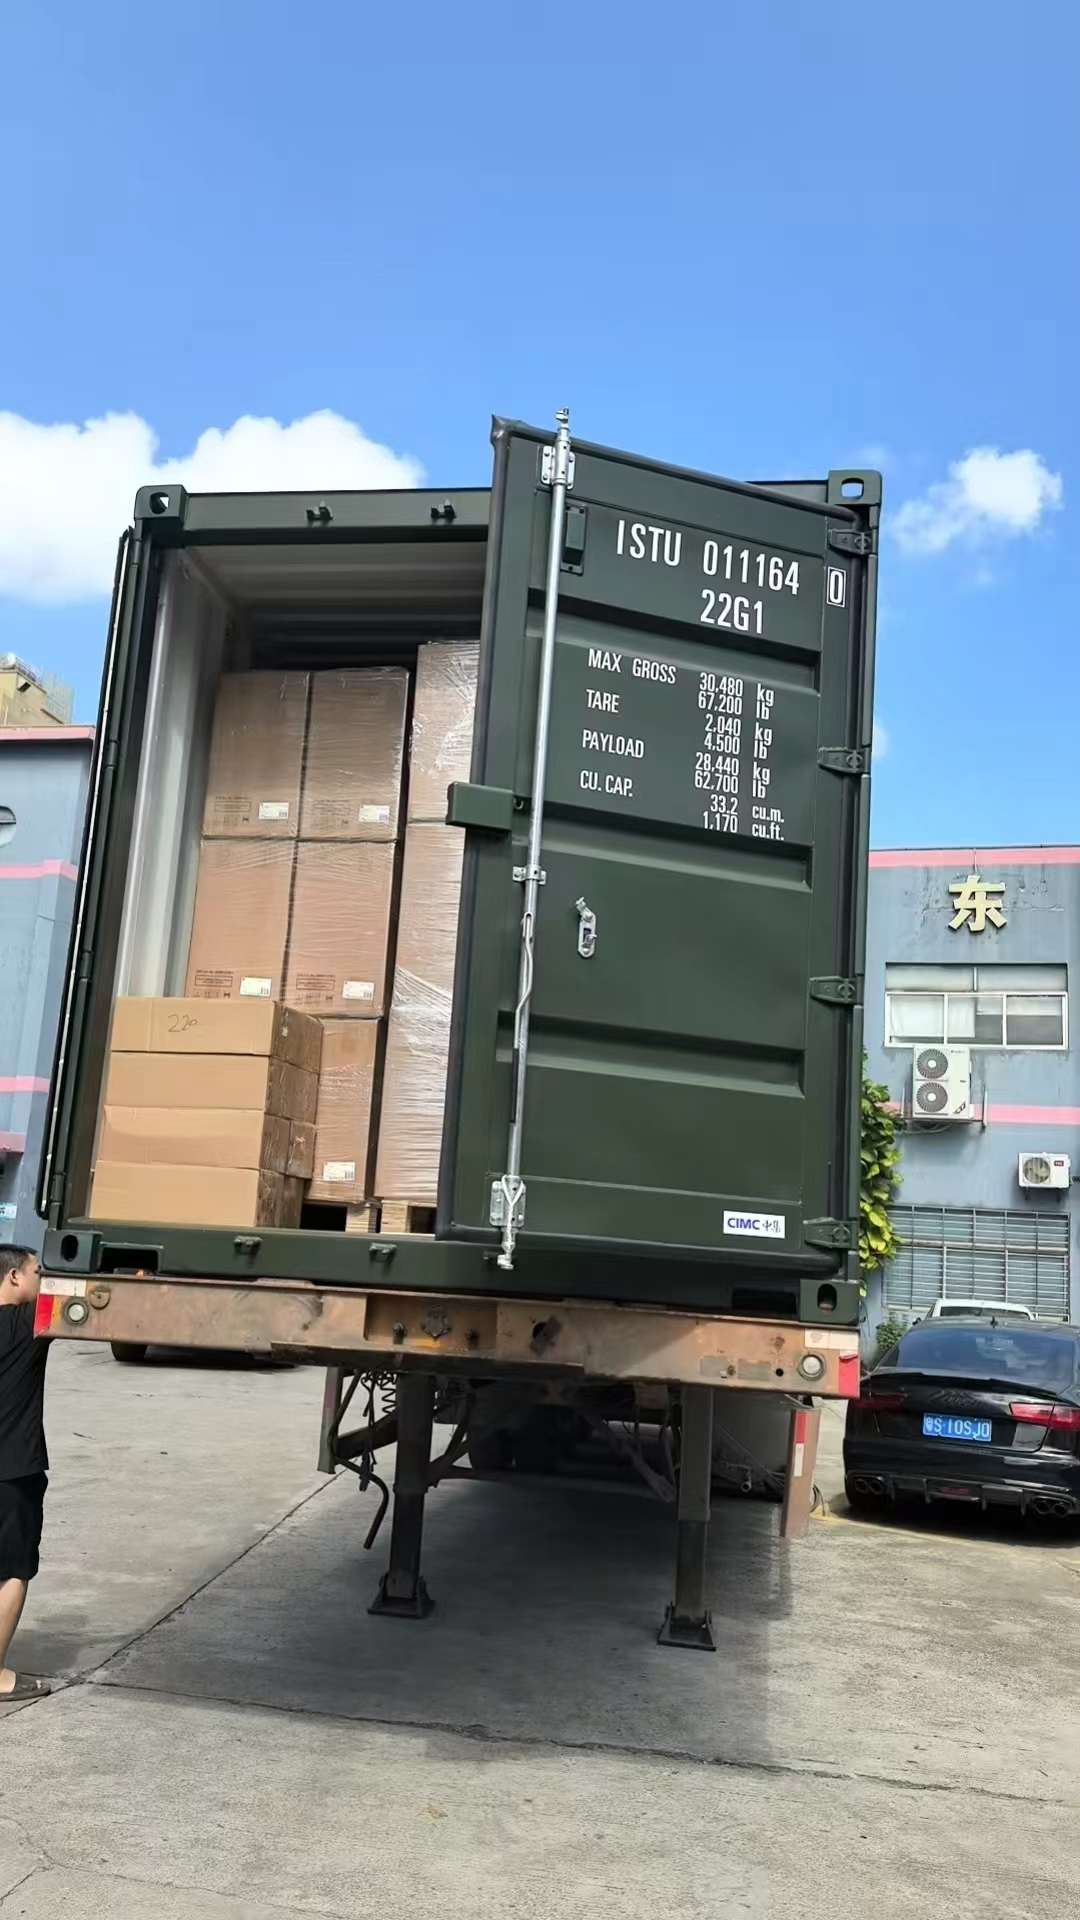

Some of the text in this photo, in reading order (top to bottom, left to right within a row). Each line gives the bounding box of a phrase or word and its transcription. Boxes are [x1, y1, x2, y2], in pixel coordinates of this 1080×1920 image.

[617, 520, 799, 594] ISTU 011164
[829, 570, 843, 604] 0
[700, 589, 763, 633] 22G1
[588, 648, 622, 672] MAX
[632, 657, 676, 684] GROSS
[757, 683, 775, 707] kg
[586, 689, 620, 713] TARE
[755, 722, 773, 746] kg
[756, 701, 769, 720] lb
[582, 729, 644, 758] PAYLOAD
[753, 761, 771, 786] kg
[754, 740, 768, 759] lb
[753, 780, 766, 798] lb
[710, 793, 738, 815] 33.2
[752, 804, 785, 823] cu.m.
[752, 821, 785, 841] cu.ft.
[948, 874, 1007, 932] 东
[727, 1217, 760, 1230] CIMC
